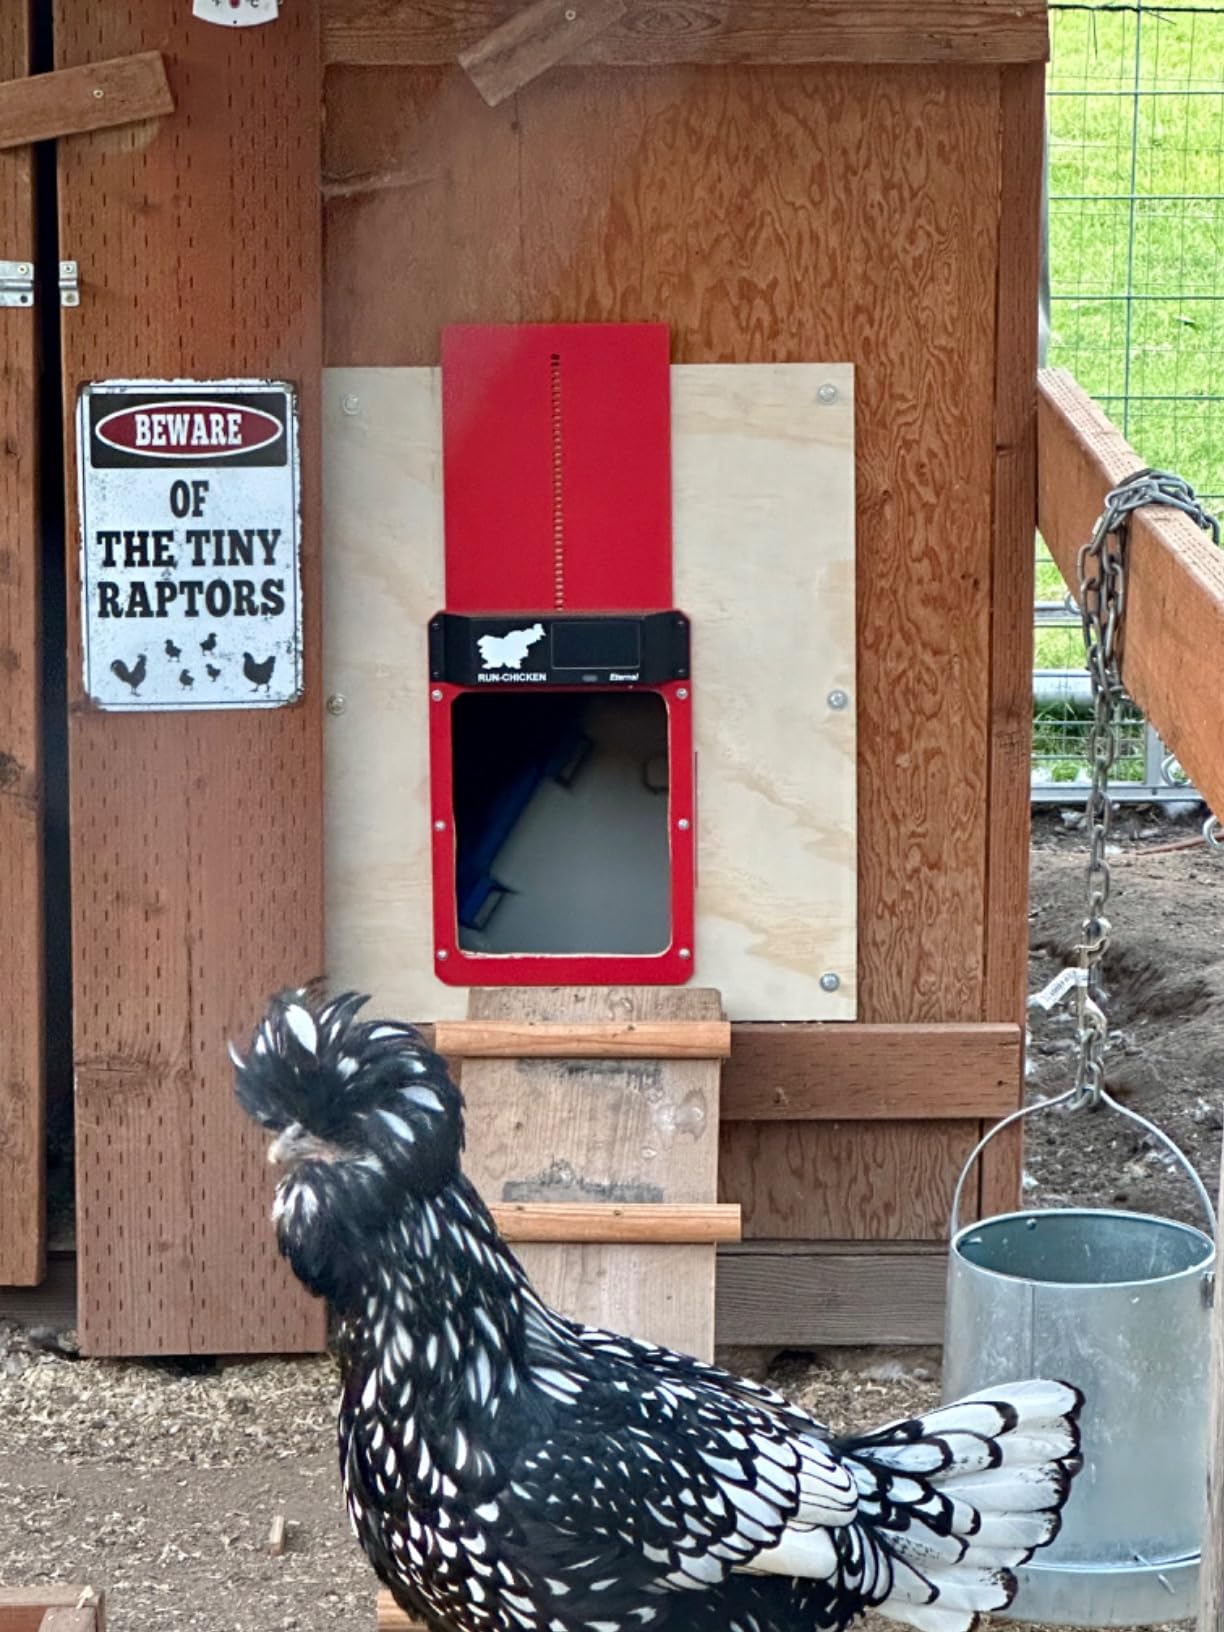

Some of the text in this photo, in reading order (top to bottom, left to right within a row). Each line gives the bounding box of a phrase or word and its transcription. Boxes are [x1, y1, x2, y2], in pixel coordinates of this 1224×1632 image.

[135, 414, 243, 446] BEWARE
[170, 480, 210, 518] OF
[97, 530, 282, 567] THE TINY
[98, 579, 286, 618] RAPTORS
[477, 673, 547, 682] RUN-CHICKEN
[609, 673, 639, 682] Eternal
